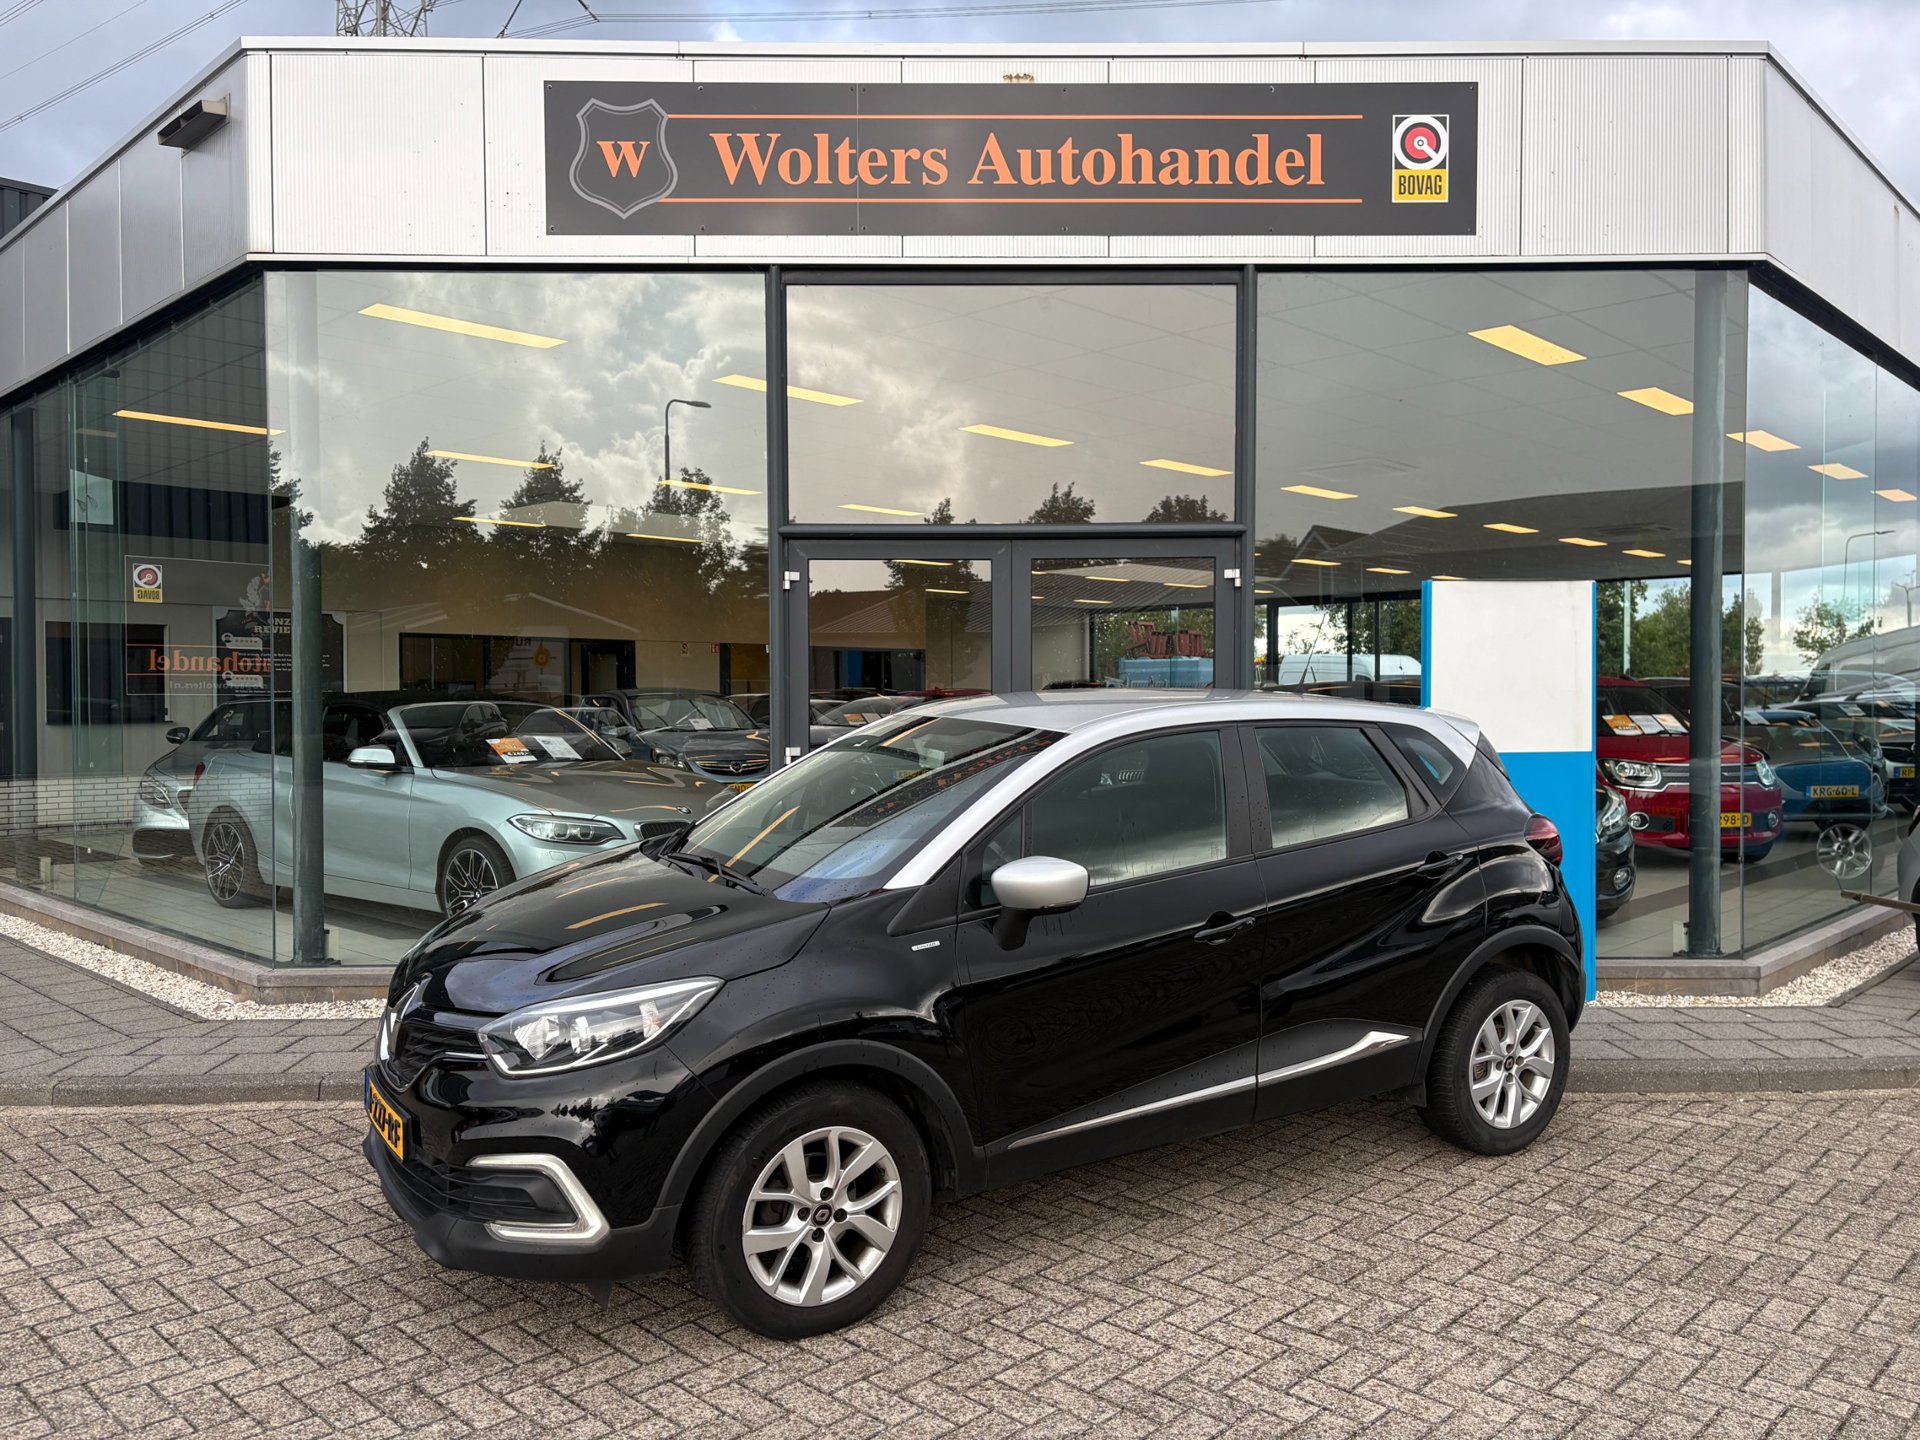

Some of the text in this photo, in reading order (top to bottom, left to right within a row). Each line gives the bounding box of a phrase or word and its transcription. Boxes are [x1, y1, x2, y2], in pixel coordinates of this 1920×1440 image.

[596, 140, 651, 178] W
[709, 131, 1326, 186] Wolters Autohandel
[1397, 174, 1443, 197] BOVAG
[1812, 787, 1857, 798] KRG-60-L
